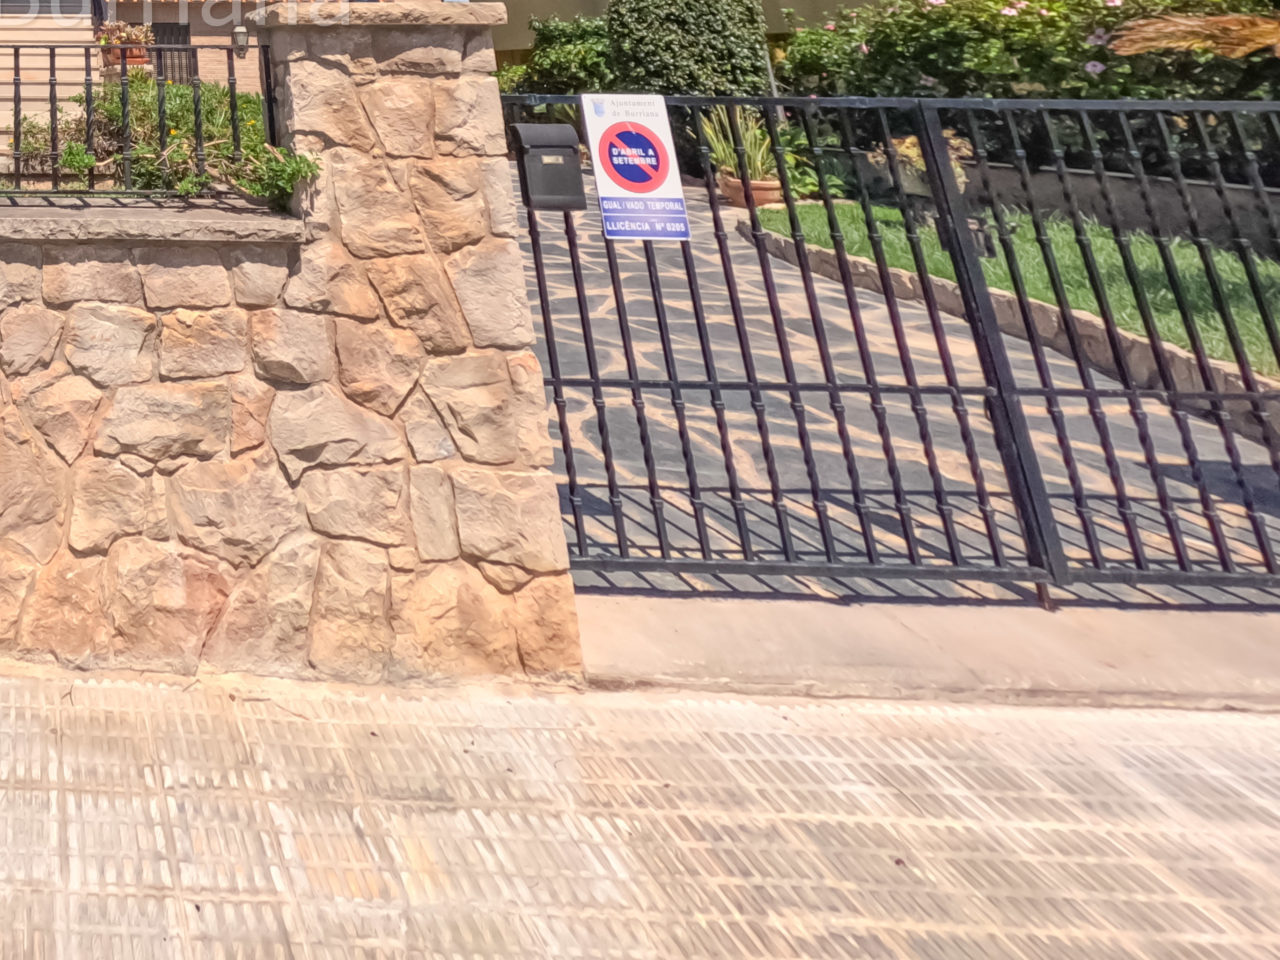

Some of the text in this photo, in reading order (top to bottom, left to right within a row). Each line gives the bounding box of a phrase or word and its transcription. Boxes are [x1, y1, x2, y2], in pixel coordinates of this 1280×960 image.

[610, 99, 655, 108] Ajuntament
[625, 109, 659, 117] Burriana
[611, 147, 655, 156] D'ABRIL A
[611, 156, 658, 165] SETEMBRE
[646, 201, 684, 211] TEMPORAL
